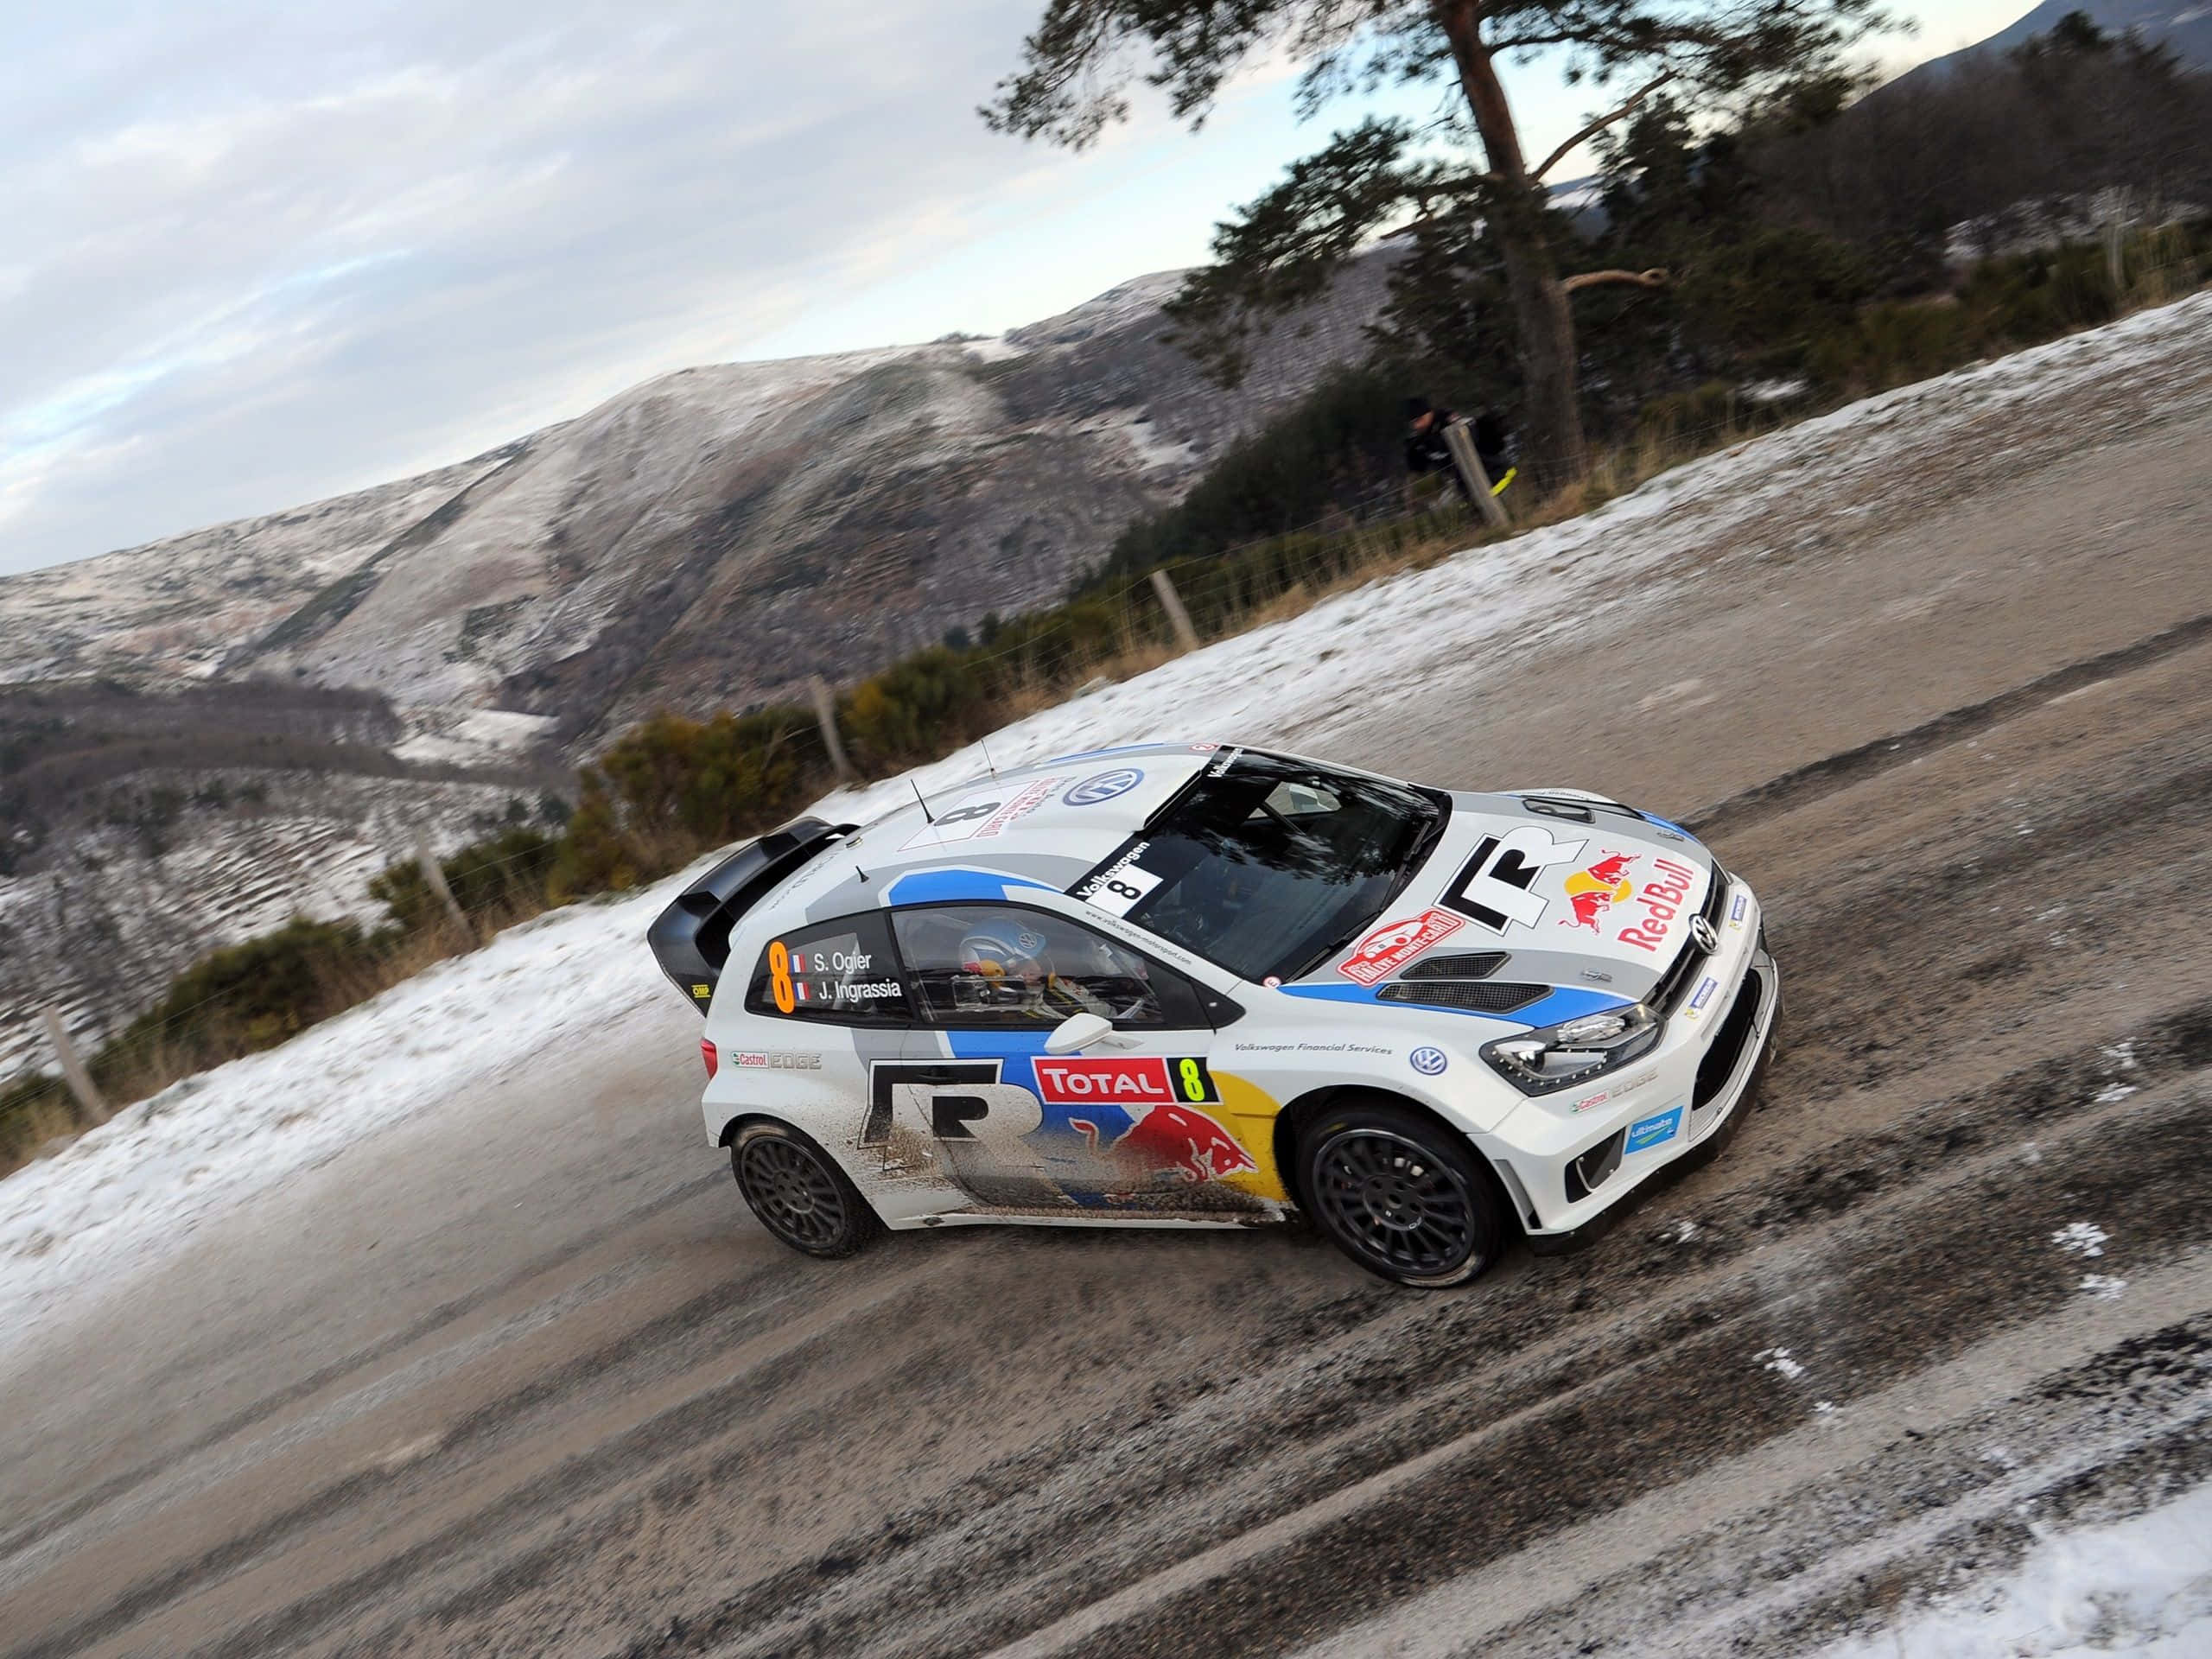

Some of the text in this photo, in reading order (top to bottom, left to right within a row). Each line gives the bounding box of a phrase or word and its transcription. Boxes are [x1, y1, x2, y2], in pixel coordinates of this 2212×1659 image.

[933, 801, 1002, 826] 8
[1076, 841, 1151, 898] Volkswagen
[1107, 880, 1142, 900] 8
[814, 950, 872, 975] S. Ogier
[1354, 955, 1398, 982] RALLYE
[768, 940, 795, 1014] 8
[692, 985, 710, 996] OMP
[818, 978, 902, 1003] J. Ingrassia
[740, 1052, 822, 1070] Castrol EDGE
[1235, 1043, 1393, 1055] Volkswagen Financial Services
[1042, 1068, 1165, 1096] TOTAL
[1179, 1058, 1206, 1102] 8
